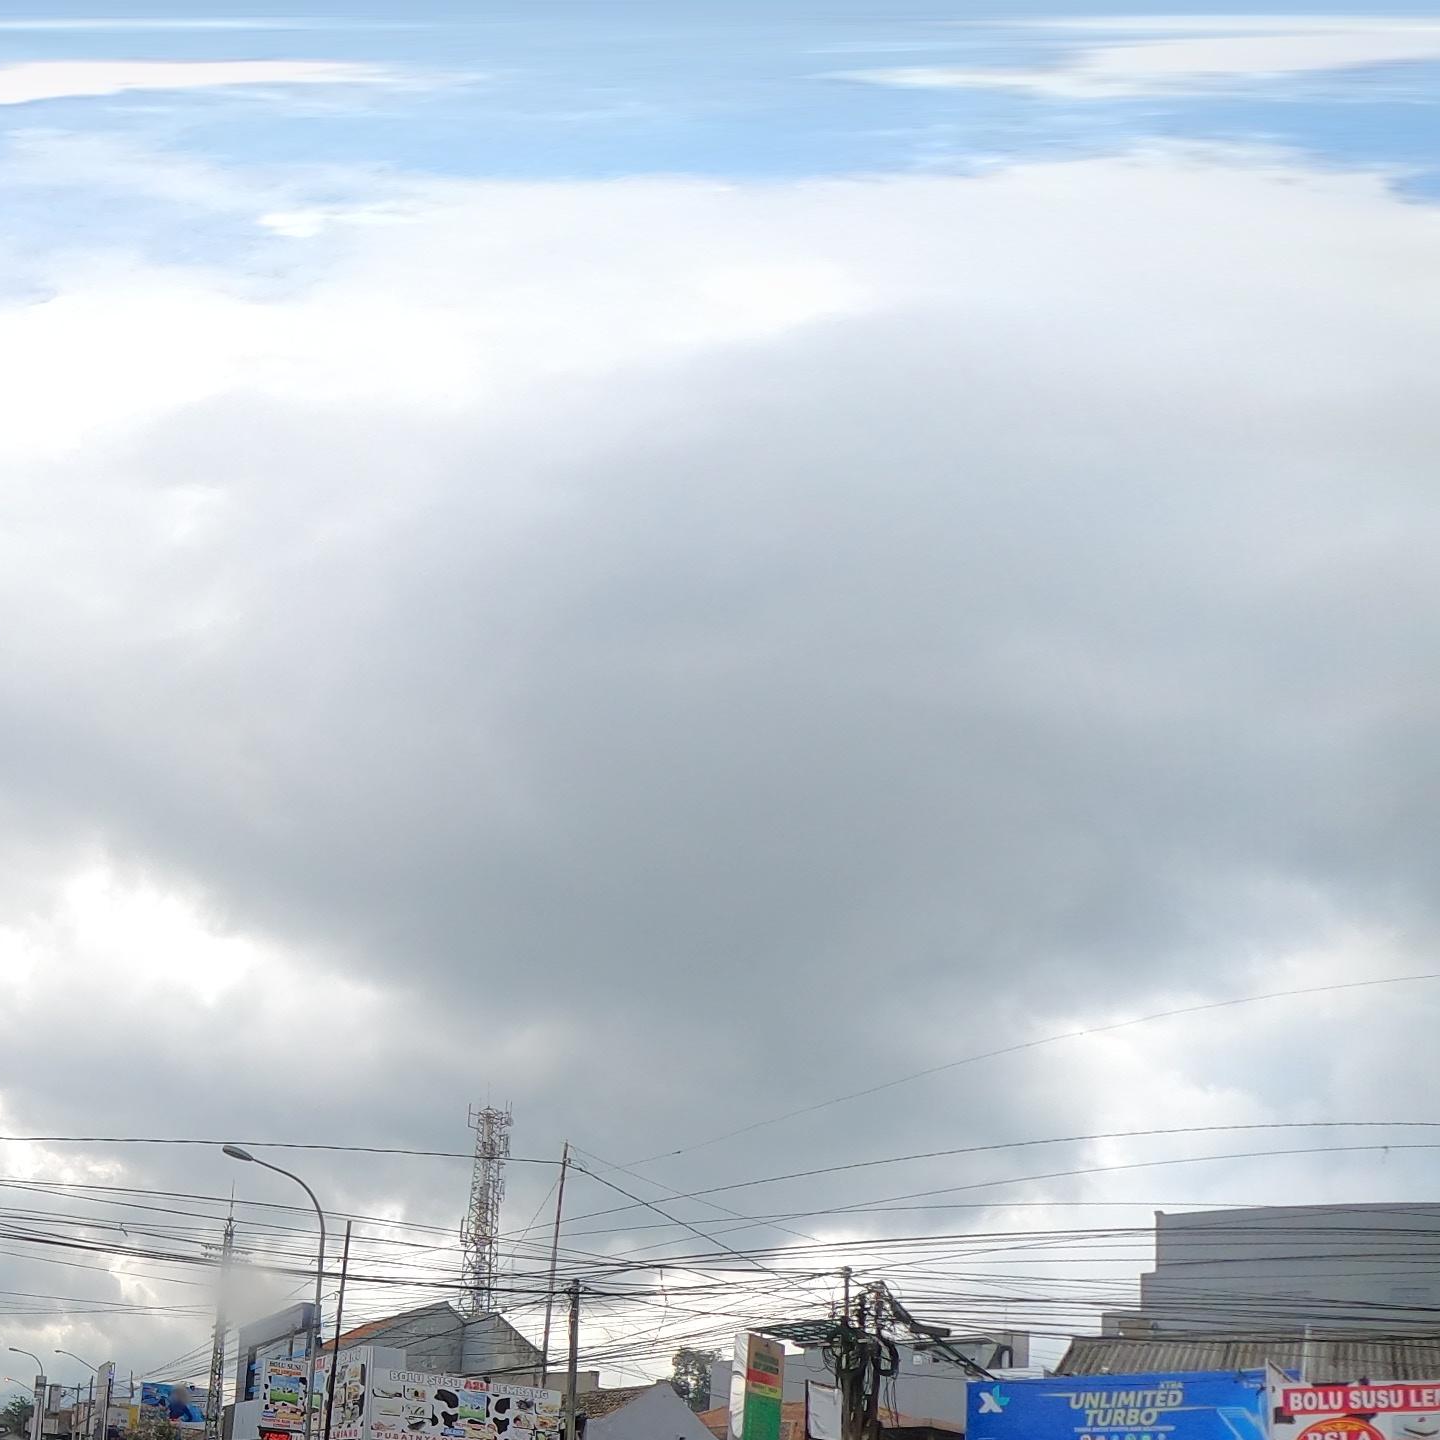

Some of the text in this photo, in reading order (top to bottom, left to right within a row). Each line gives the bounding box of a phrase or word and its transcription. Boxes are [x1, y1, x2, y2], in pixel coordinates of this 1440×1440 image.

[390, 1371, 424, 1384] BOLU
[427, 1375, 460, 1389] SUSU
[493, 1382, 548, 1399] LEMBANG
[1070, 1390, 1184, 1409] UNLIMITED
[1290, 1392, 1344, 1411] BOLU
[1349, 1389, 1404, 1408] SUSU
[1084, 1408, 1158, 1426] TURBO
